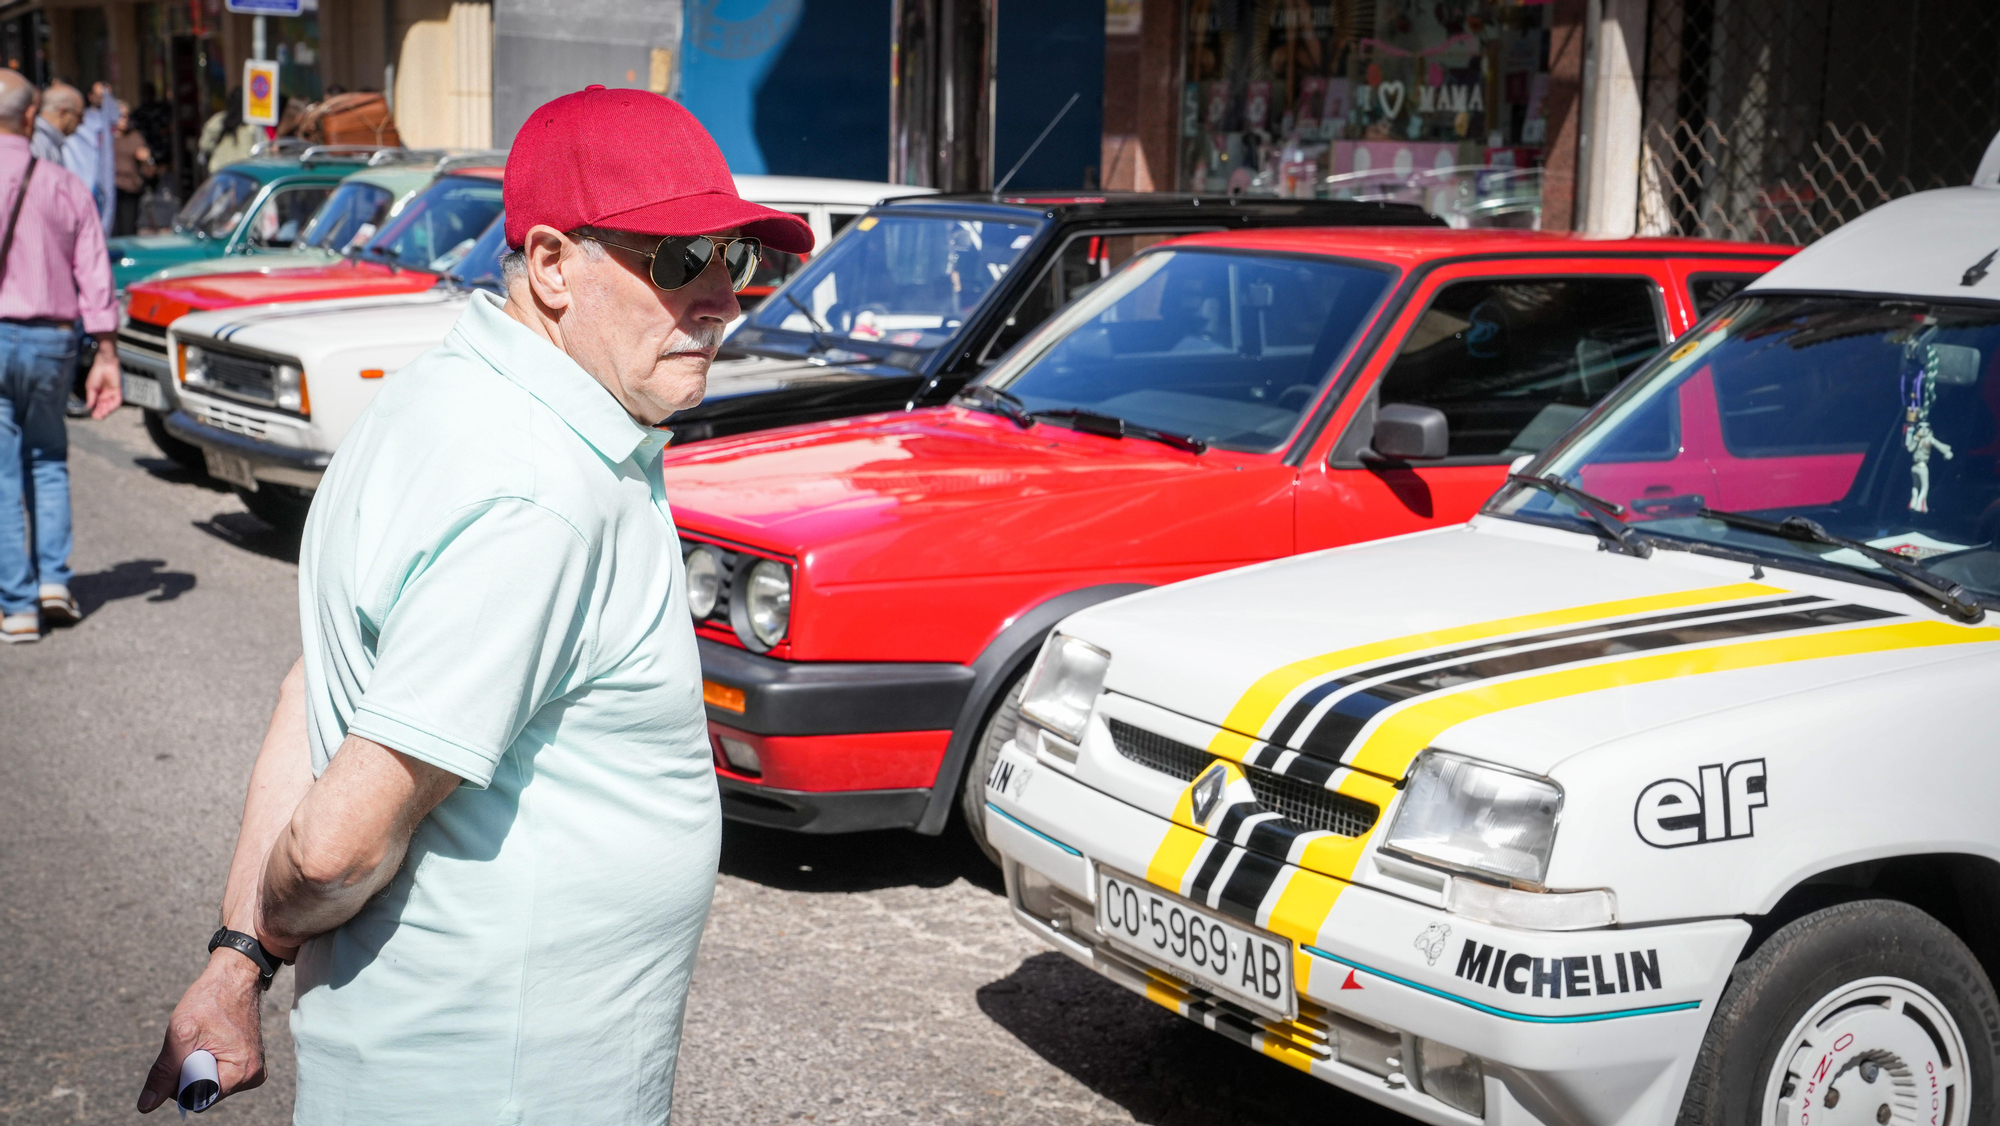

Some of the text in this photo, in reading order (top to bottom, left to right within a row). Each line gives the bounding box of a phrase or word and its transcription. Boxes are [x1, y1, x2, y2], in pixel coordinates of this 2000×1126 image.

[1418, 83, 1484, 112] MAMA
[1634, 757, 1768, 849] elf
[1455, 938, 1662, 999] MICHELIN
